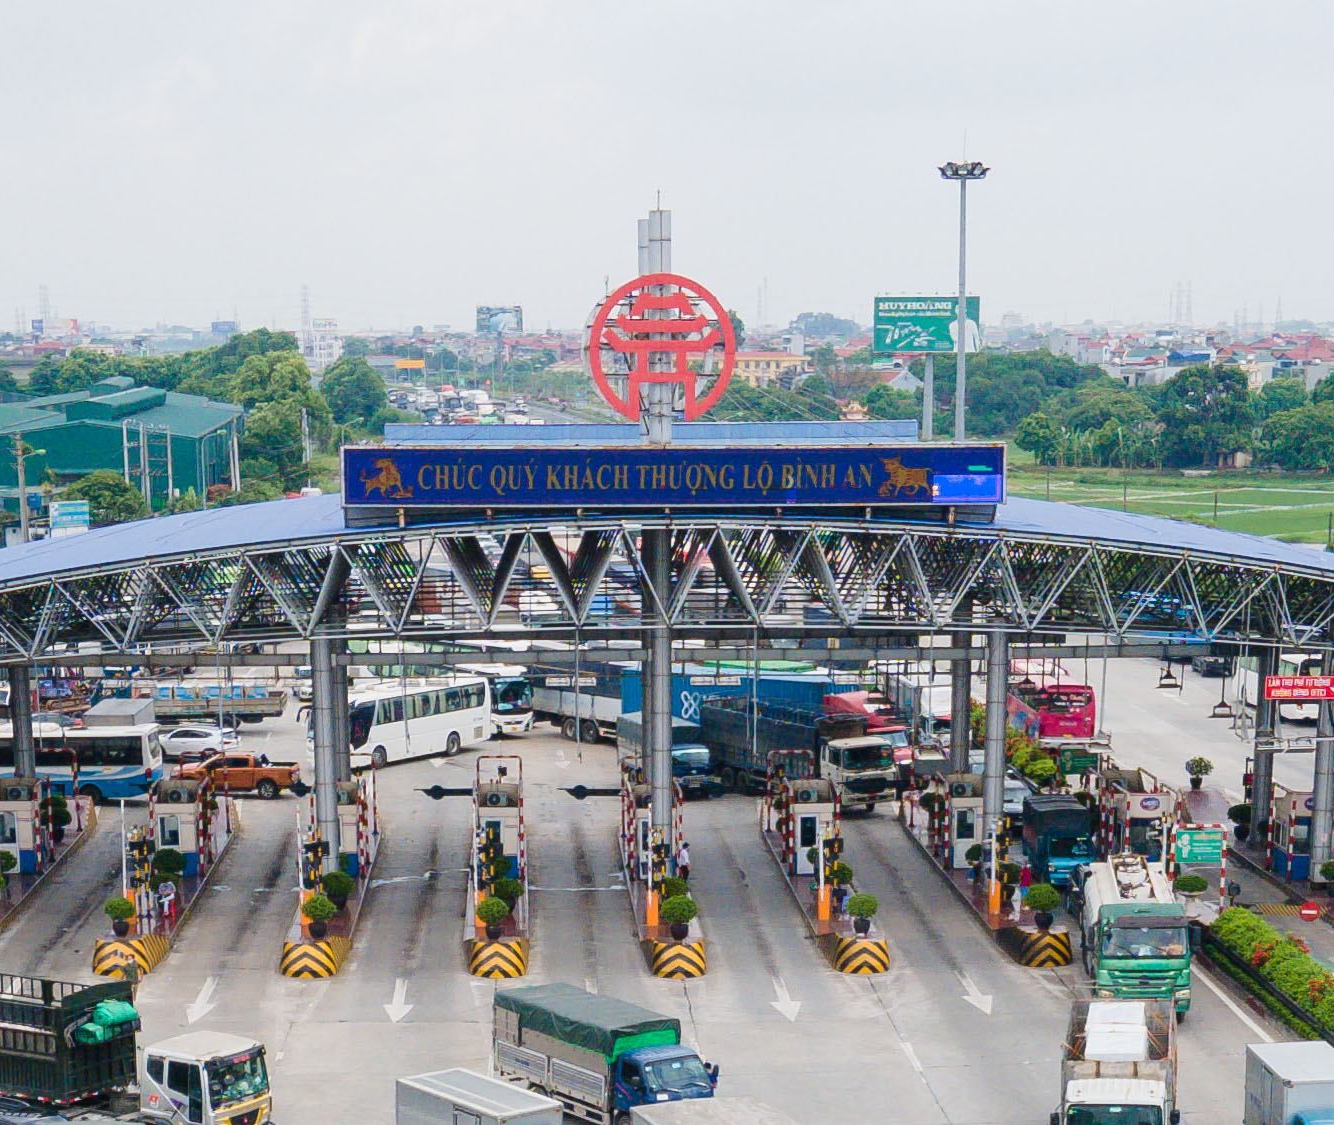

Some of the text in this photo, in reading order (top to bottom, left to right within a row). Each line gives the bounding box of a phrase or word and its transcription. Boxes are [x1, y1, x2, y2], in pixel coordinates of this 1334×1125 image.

[418, 457, 875, 496] CHÚC QUÝ KHÁCH THƯỢNG LỘ BÌNH AN
